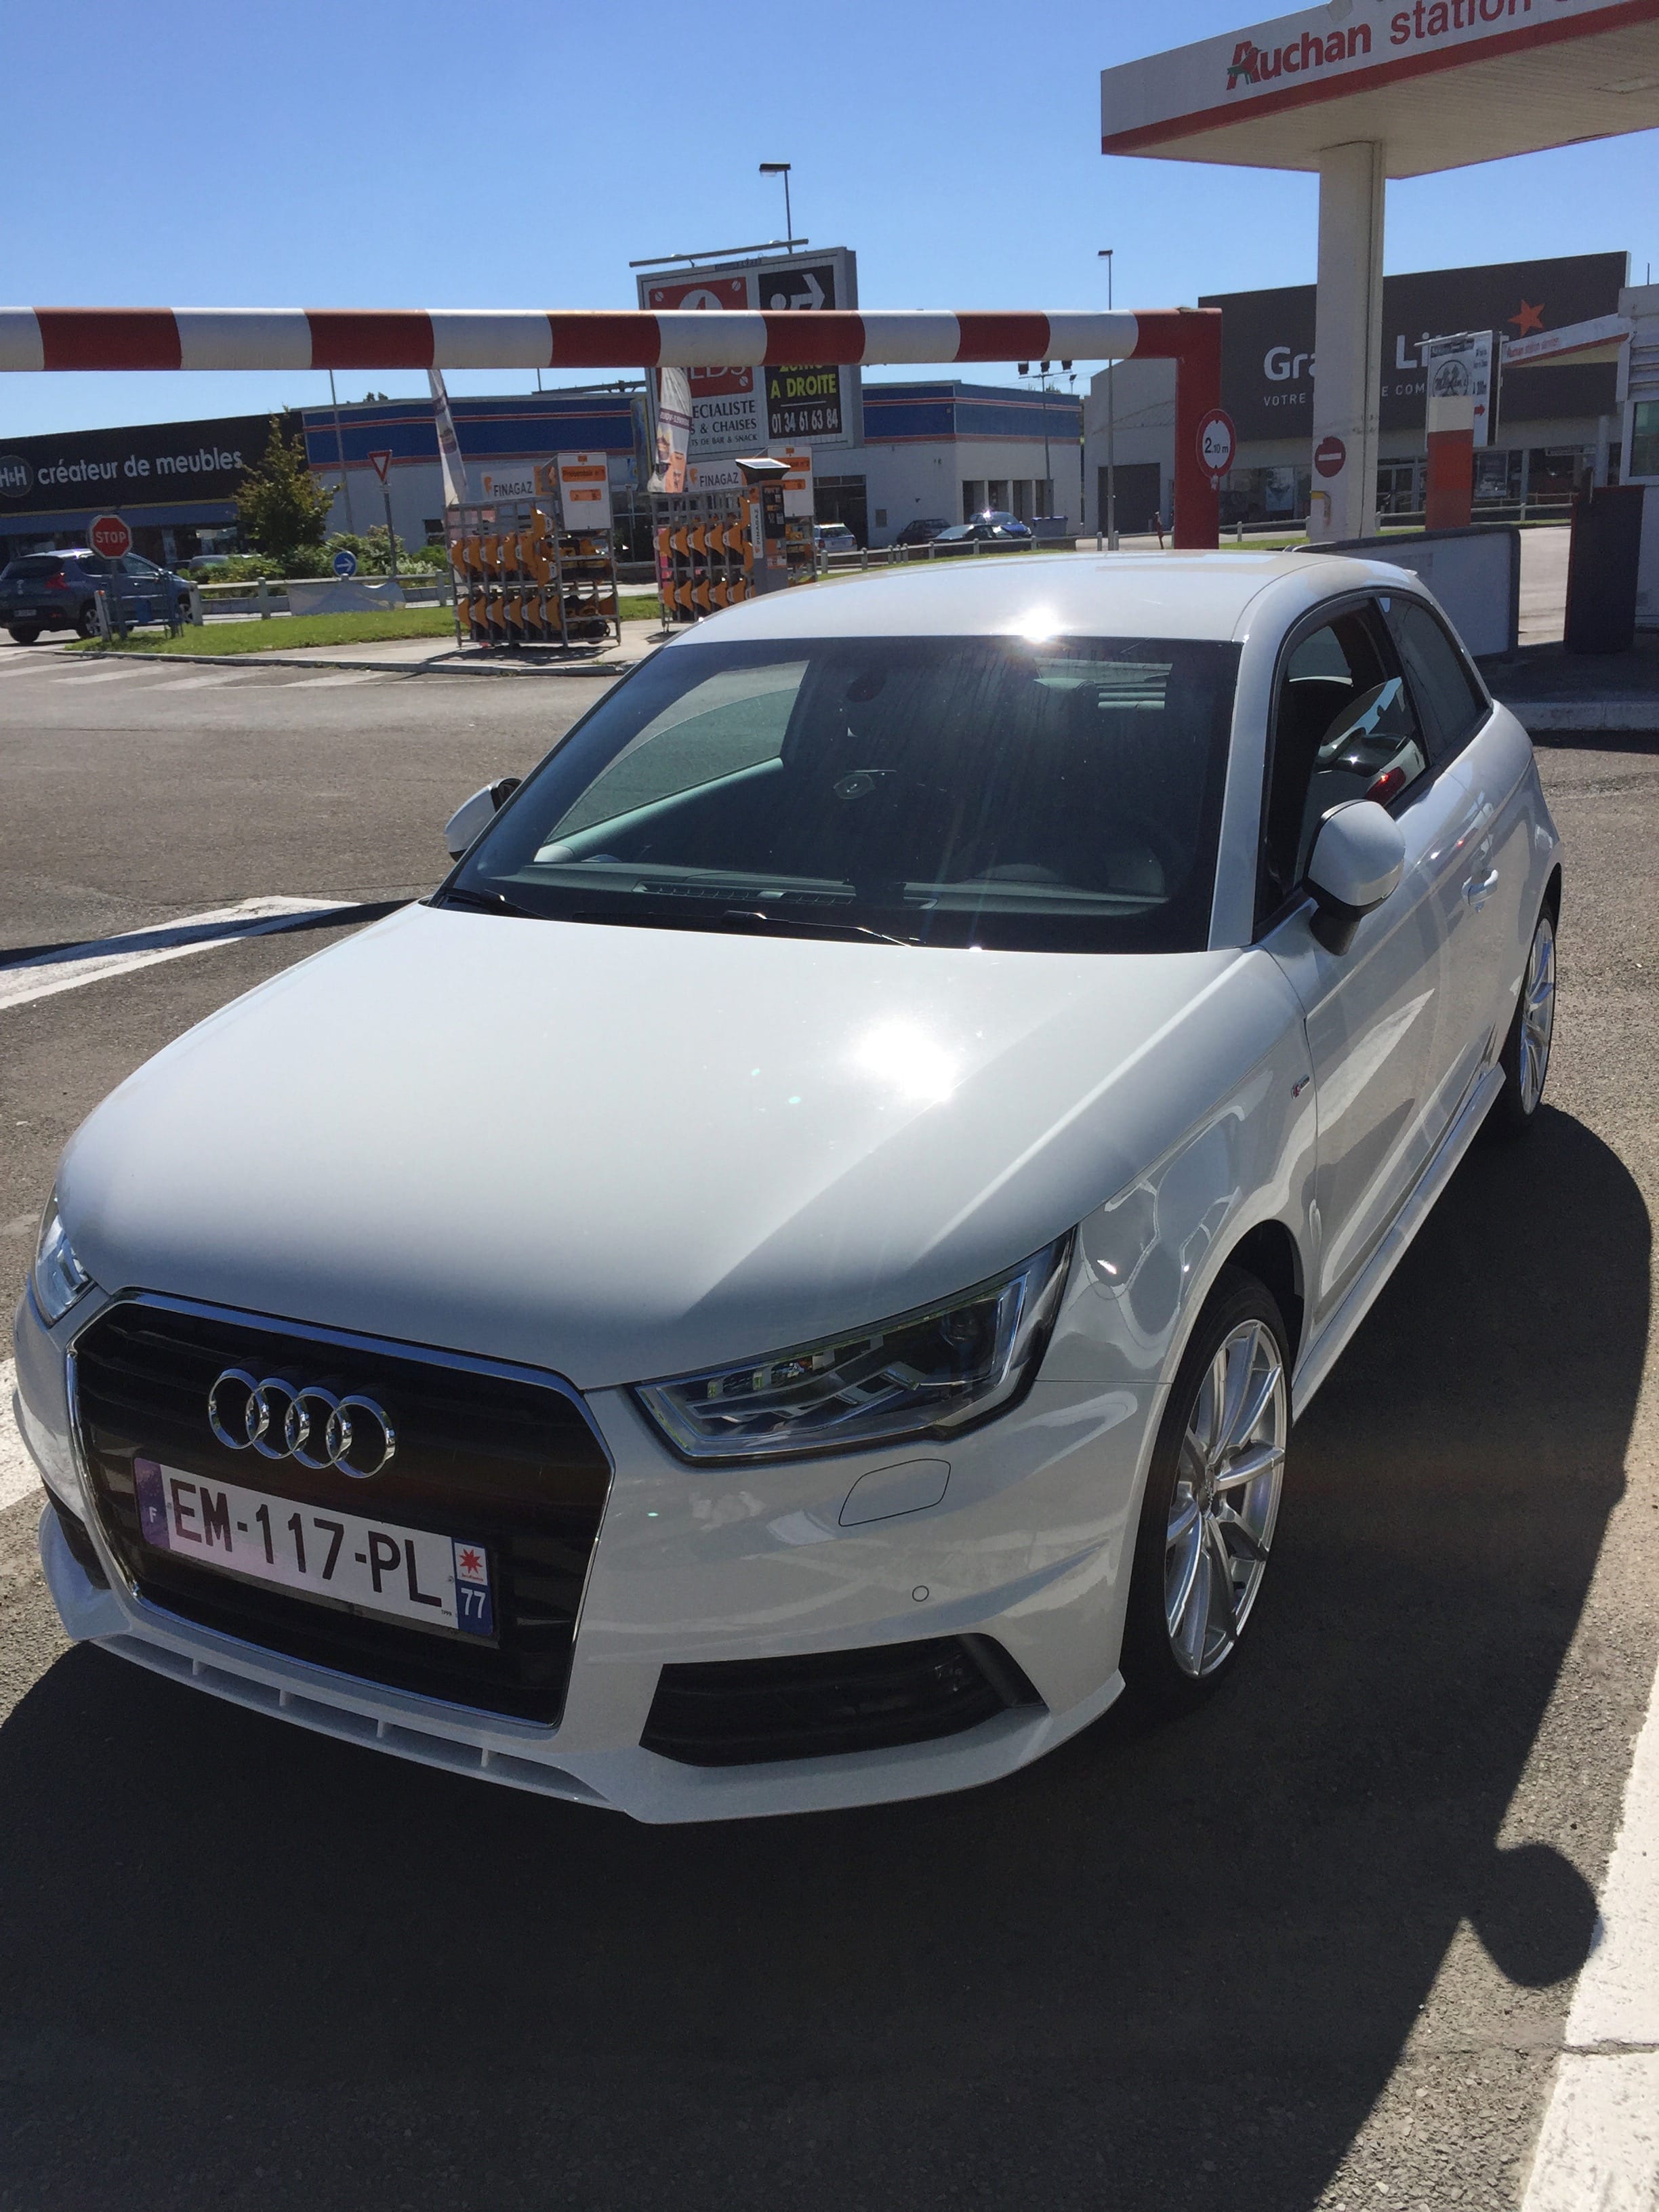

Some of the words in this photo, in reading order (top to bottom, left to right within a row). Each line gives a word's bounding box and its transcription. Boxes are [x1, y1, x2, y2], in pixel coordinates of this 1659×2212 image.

[1227, 23, 1372, 91] Auchan
[771, 380, 781, 399] A
[786, 374, 836, 398] DROITE
[1263, 392, 1307, 407] VOTRE
[693, 400, 756, 419] ECIALISTE
[700, 423, 708, 434] &
[712, 418, 757, 433] CHAISES
[771, 413, 781, 434] 01
[784, 412, 796, 432] 34
[799, 411, 808, 430] 61
[811, 409, 823, 430] 63
[826, 408, 838, 428] 84
[735, 434, 758, 443] SNACK
[37, 459, 118, 485] créateur
[123, 455, 150, 478] de
[157, 447, 243, 474] meubles
[699, 472, 739, 487] FINAGAZ
[493, 481, 533, 497] FINAGAZ
[95, 531, 126, 543] STOP
[148, 1506, 157, 1523] F
[169, 1477, 443, 1608] EM-117-PL
[461, 1587, 486, 1618] 77
